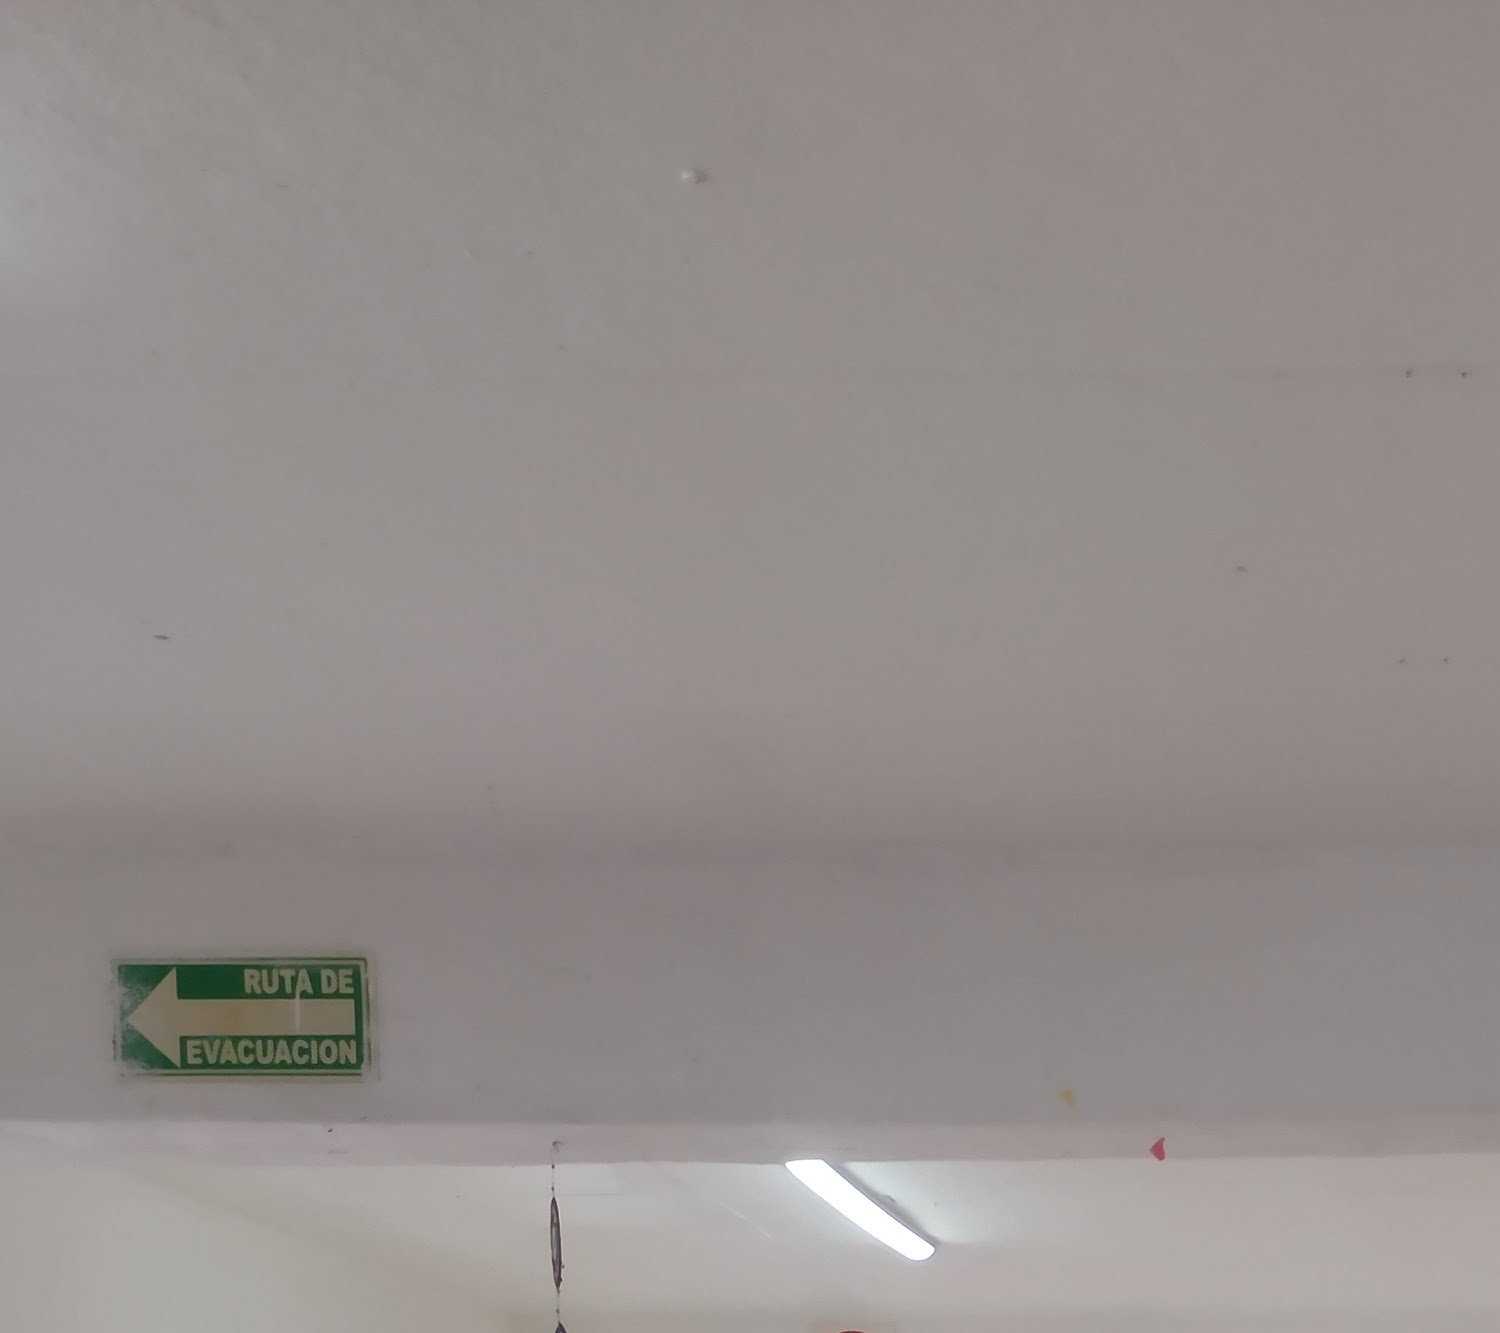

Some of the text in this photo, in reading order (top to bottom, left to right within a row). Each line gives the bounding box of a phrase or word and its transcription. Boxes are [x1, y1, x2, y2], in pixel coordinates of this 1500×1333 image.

[244, 968, 355, 994] RUTA DE
[186, 1039, 357, 1065] EVACUACION
